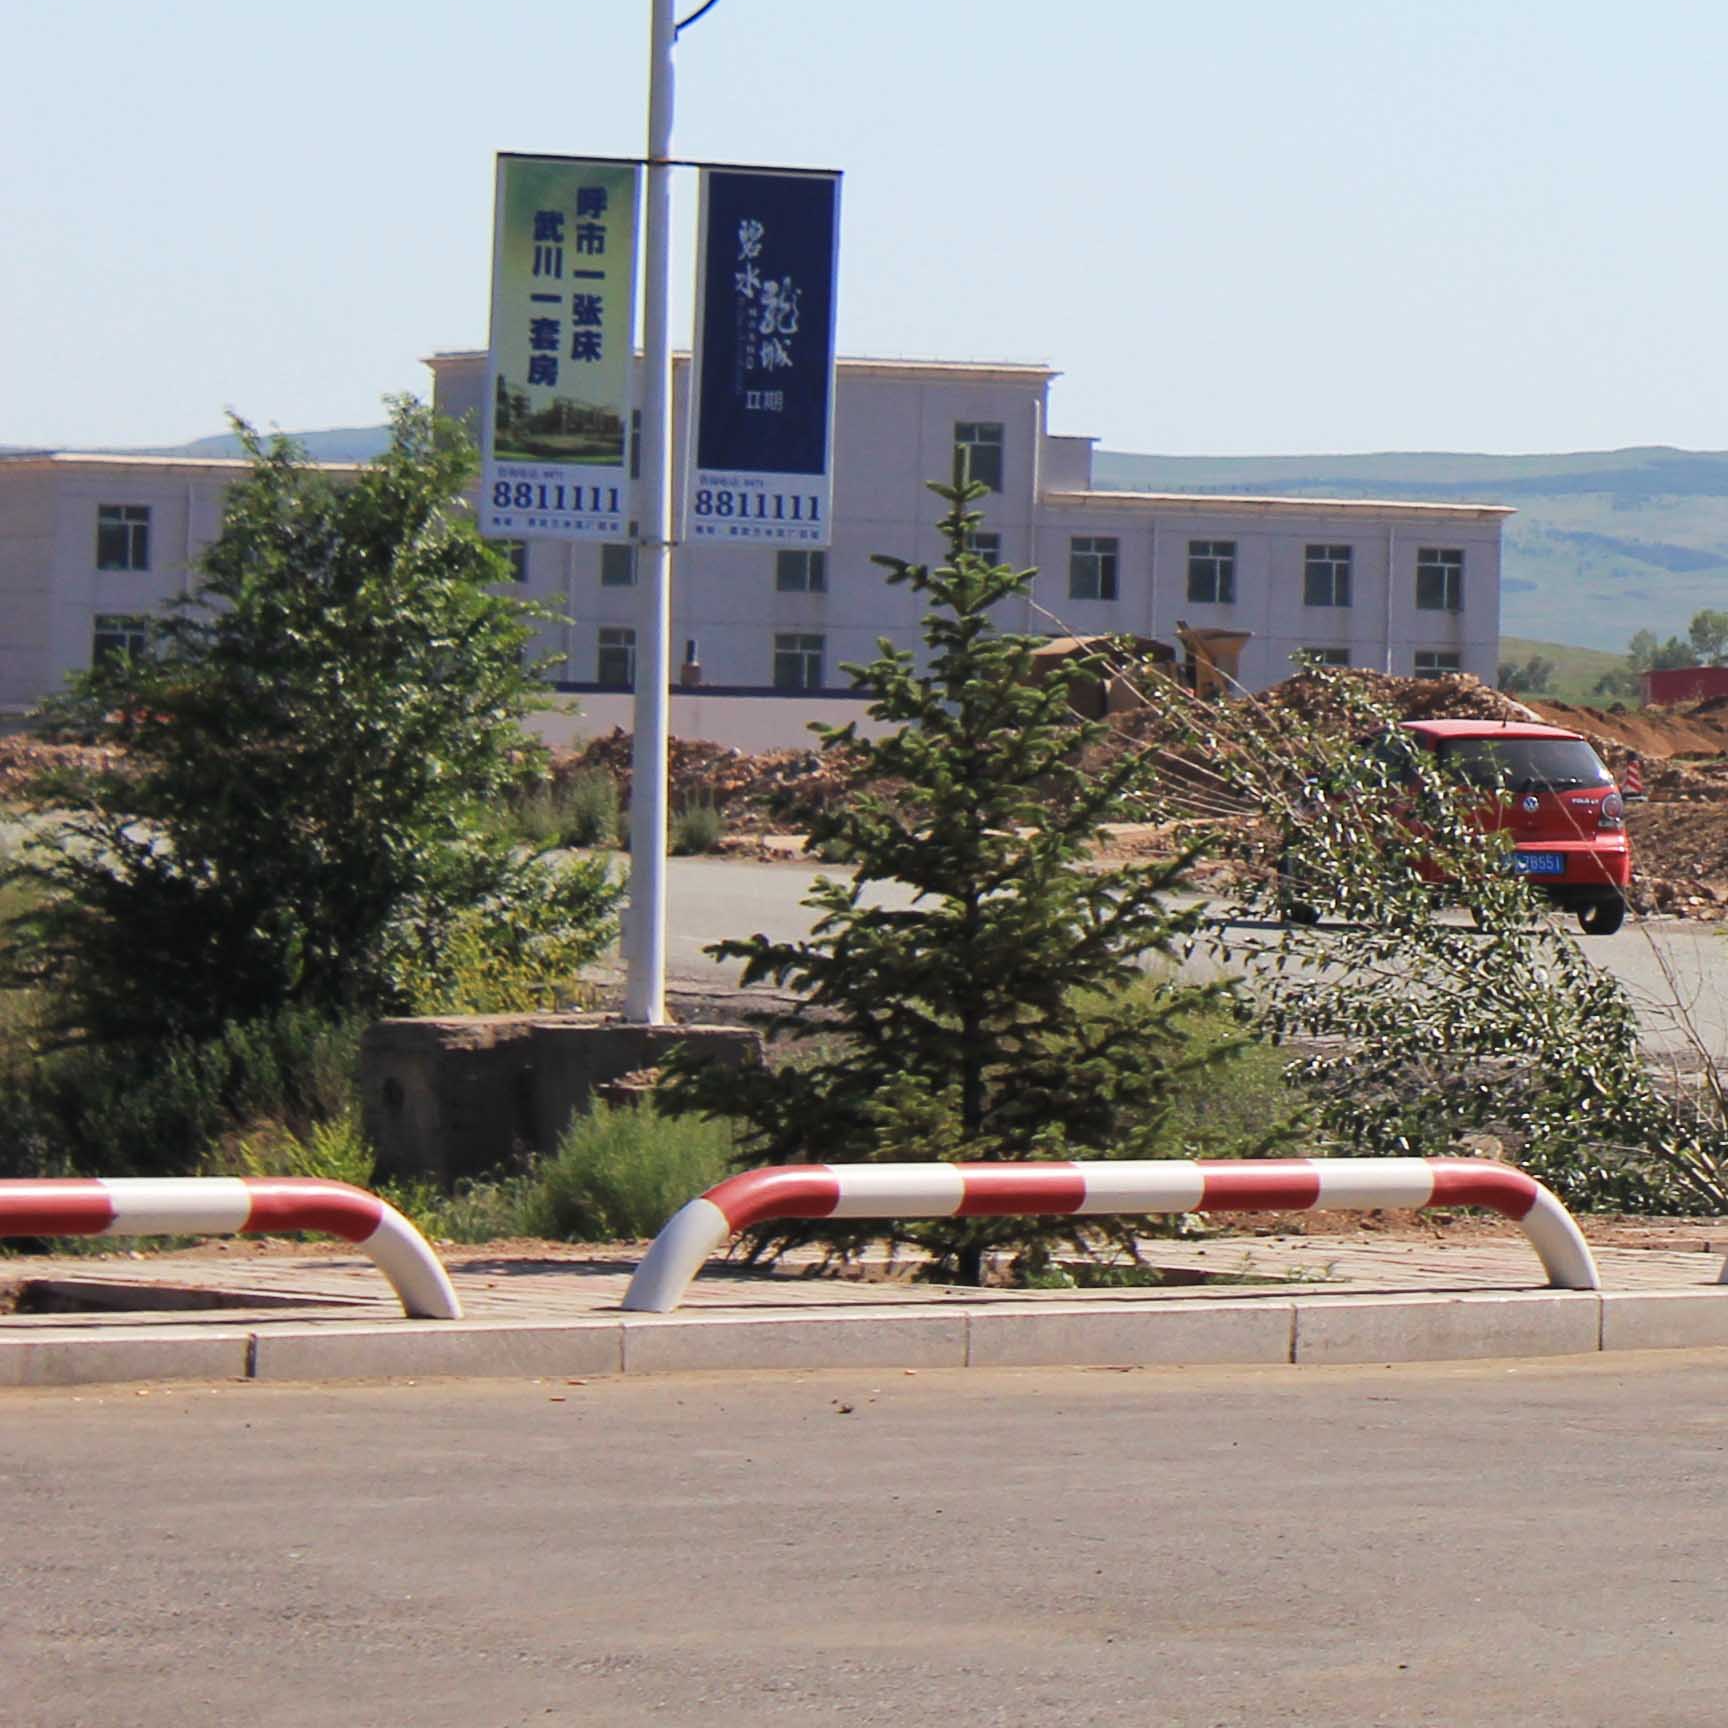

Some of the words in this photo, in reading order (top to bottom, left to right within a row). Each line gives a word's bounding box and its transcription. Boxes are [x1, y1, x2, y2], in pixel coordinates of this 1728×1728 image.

[527, 210, 565, 387] 武川一套房
[493, 481, 620, 513] 8811111
[694, 489, 820, 521] 8811111
